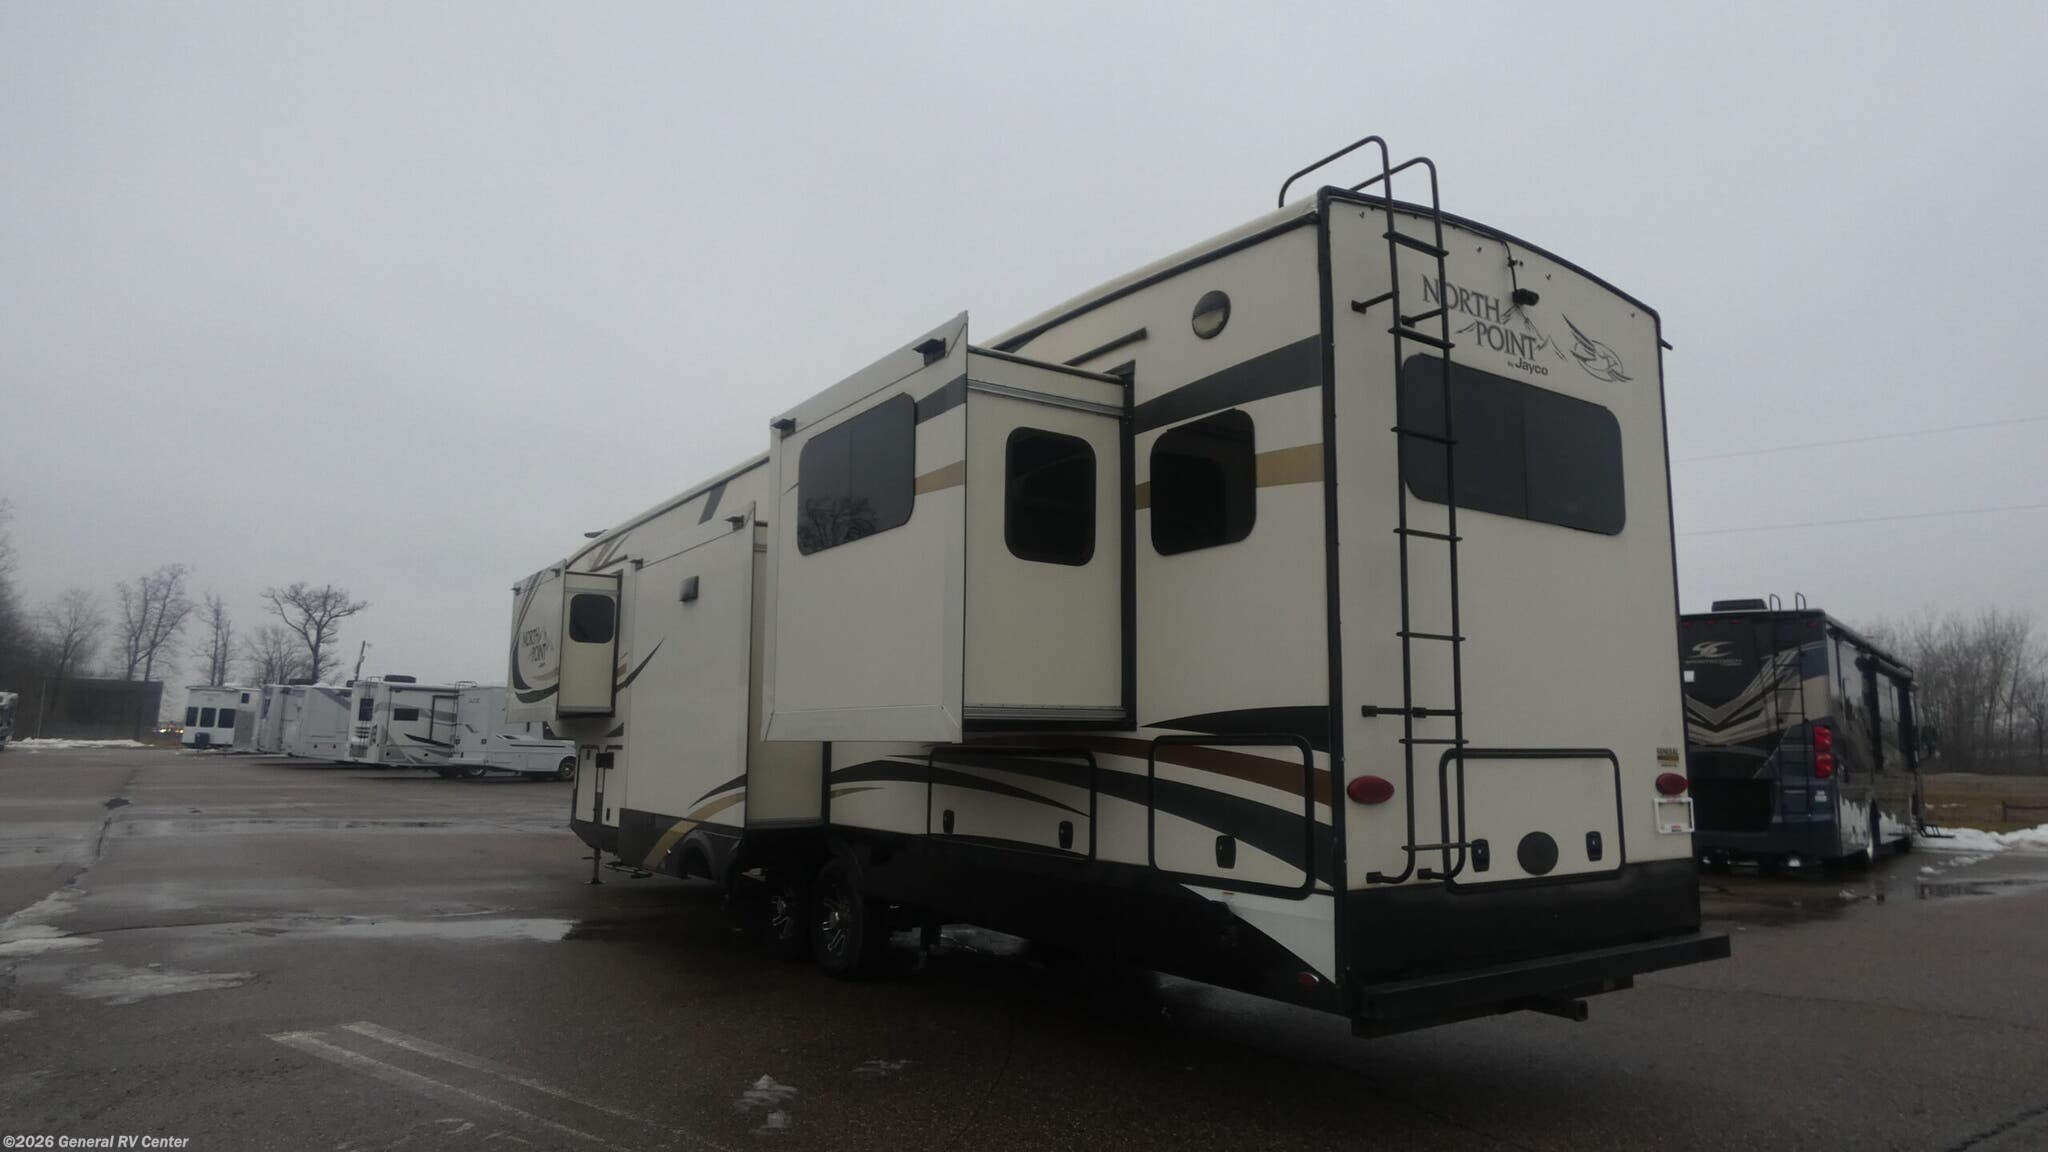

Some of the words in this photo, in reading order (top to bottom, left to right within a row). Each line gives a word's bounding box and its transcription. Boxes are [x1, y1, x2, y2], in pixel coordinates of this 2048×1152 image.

[1422, 274, 1502, 323] NORTH
[1475, 321, 1536, 361] POINT
[1515, 357, 1549, 376] Jayco
